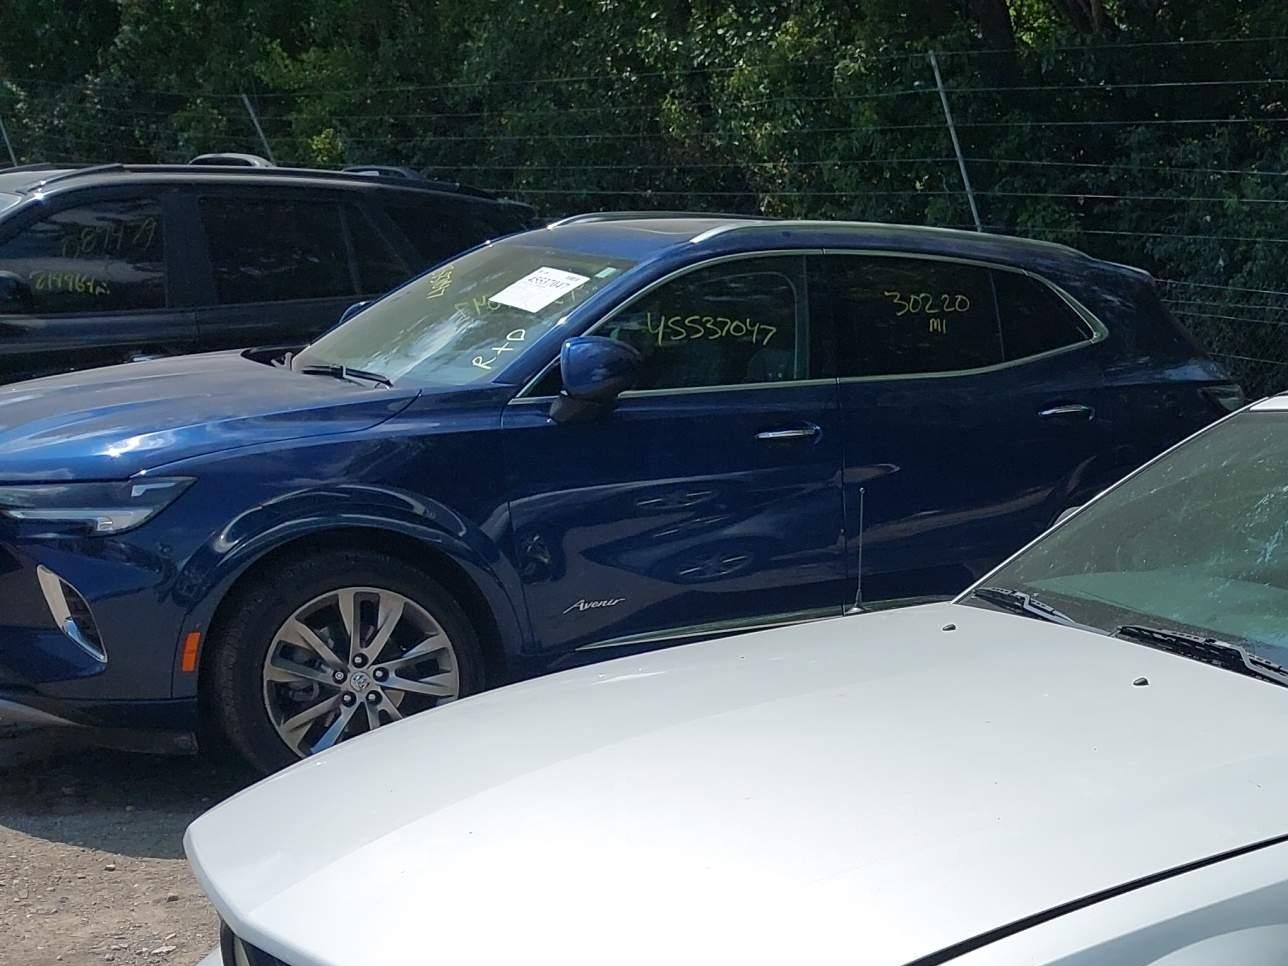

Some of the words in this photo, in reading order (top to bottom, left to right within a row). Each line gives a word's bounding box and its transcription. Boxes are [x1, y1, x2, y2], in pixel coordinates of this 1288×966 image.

[883, 291, 970, 317] 30220
[647, 312, 777, 346] 45537047
[471, 328, 527, 370] RXD
[562, 598, 626, 615] Avenir
